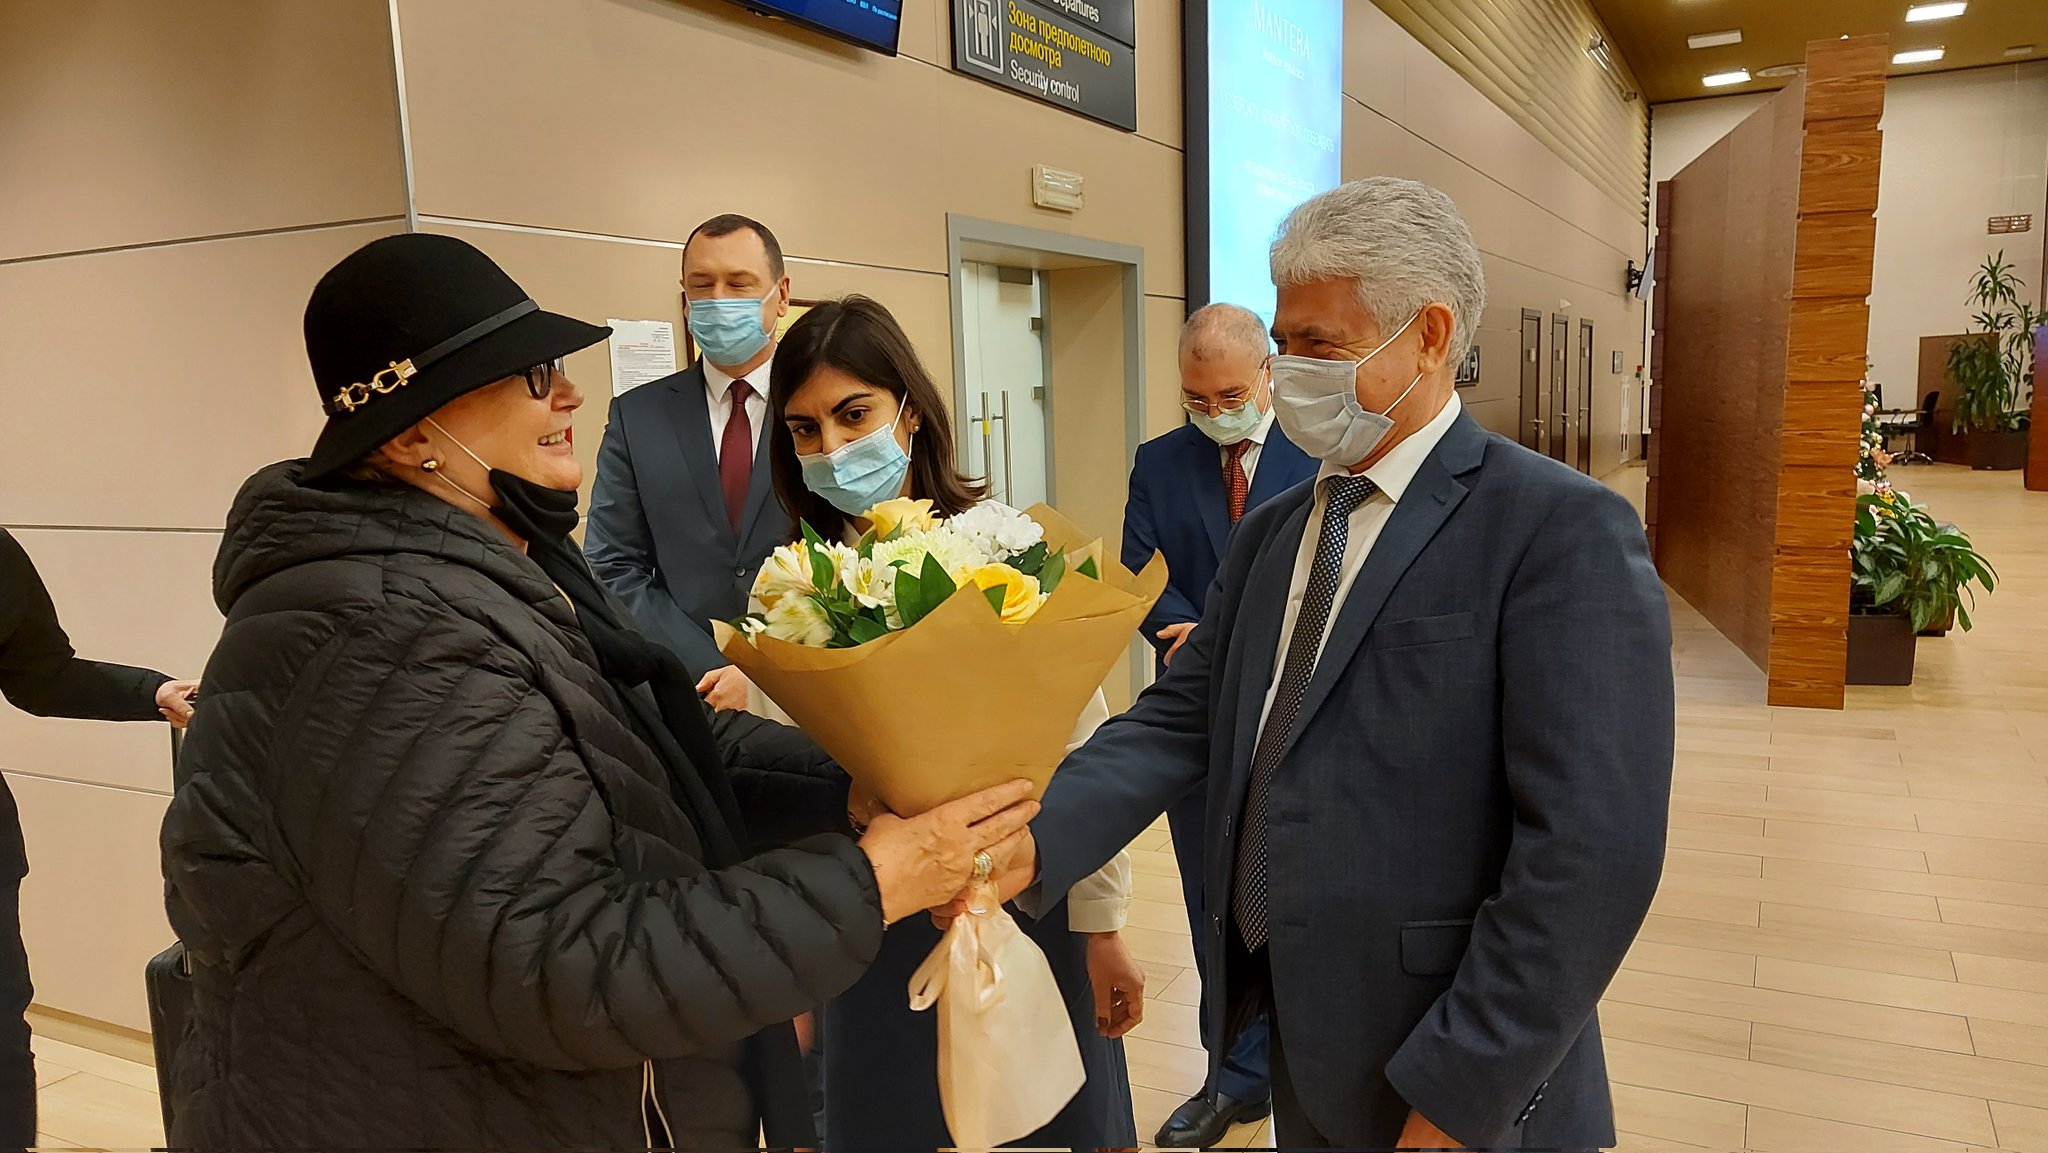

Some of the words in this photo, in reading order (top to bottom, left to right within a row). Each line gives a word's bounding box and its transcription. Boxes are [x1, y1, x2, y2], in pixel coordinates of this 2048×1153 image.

[1008, 1, 1036, 33] Зона
[1038, 19, 1111, 67] предполетного
[1009, 31, 1062, 69] досмотра
[1254, 0, 1310, 60] MANTERA
[1010, 59, 1049, 96] Security
[1050, 79, 1080, 103] control
